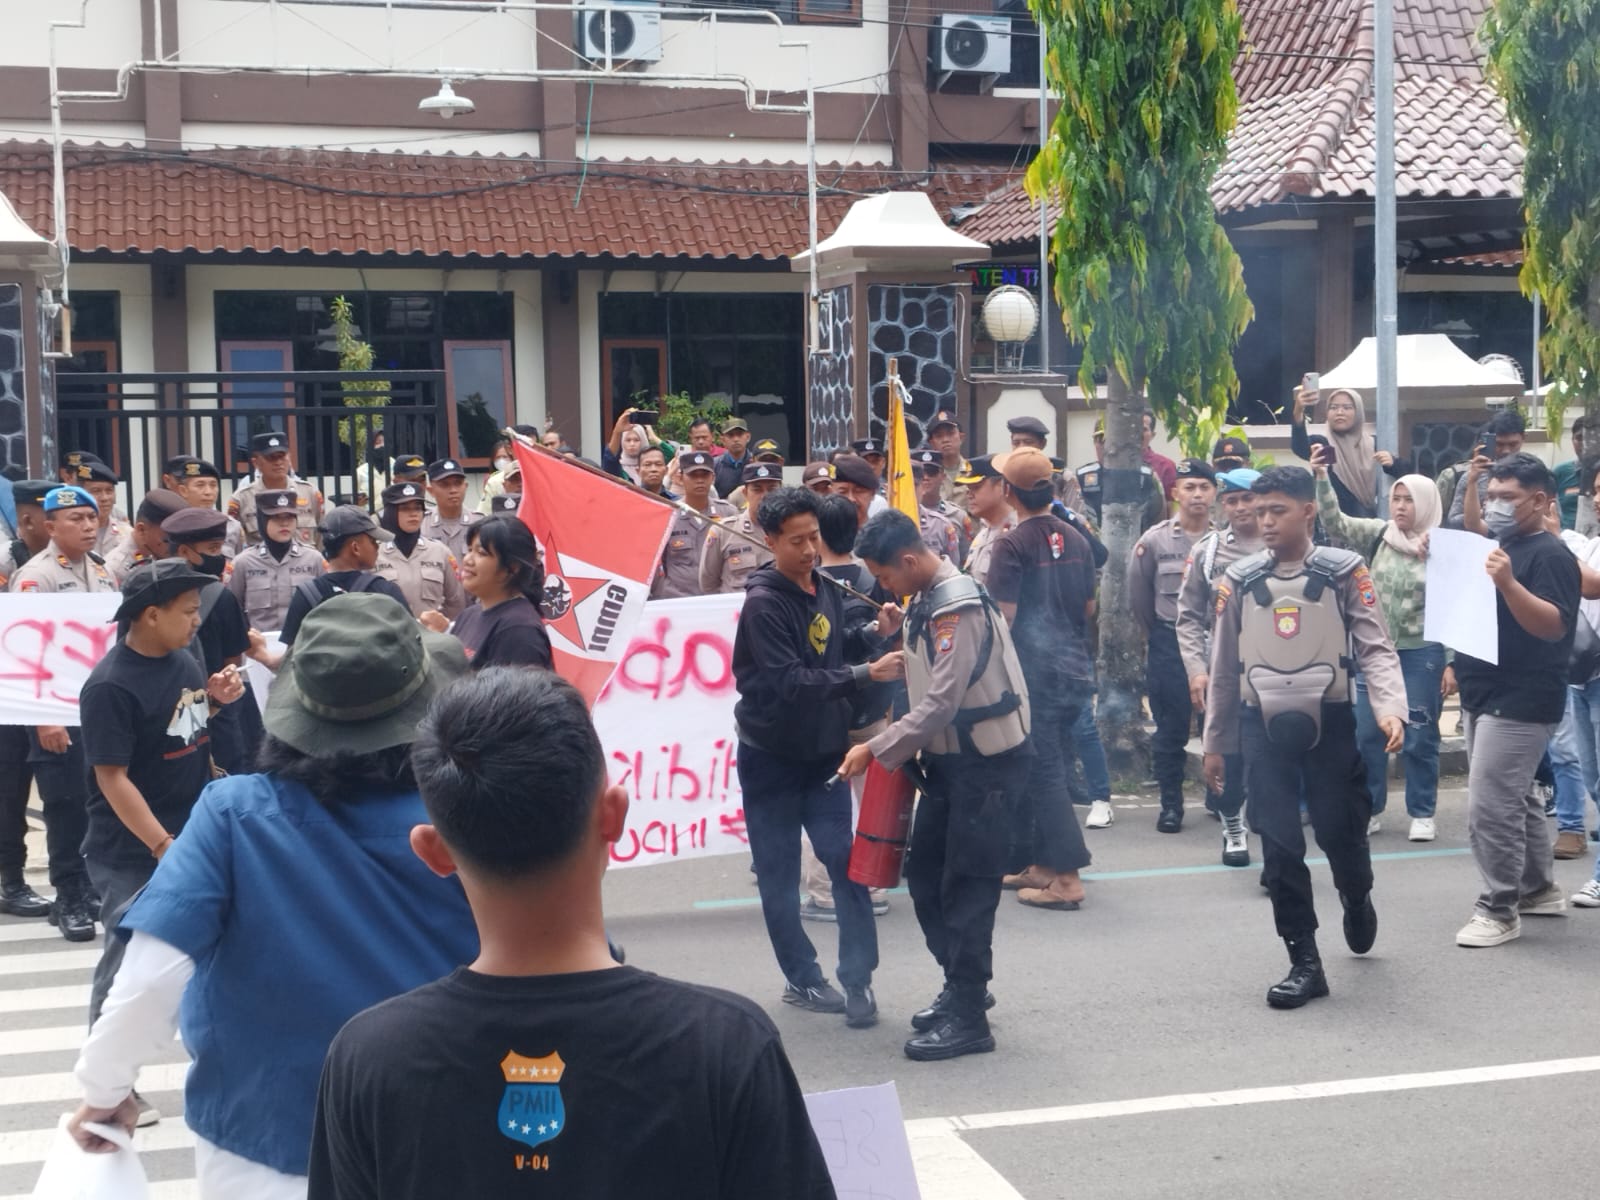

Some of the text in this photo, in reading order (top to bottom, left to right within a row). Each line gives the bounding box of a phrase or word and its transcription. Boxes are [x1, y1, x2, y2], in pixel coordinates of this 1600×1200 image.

[958, 268, 1017, 286] ATEN
[509, 1091, 556, 1114] PMII
[515, 1154, 549, 1170] V-04
